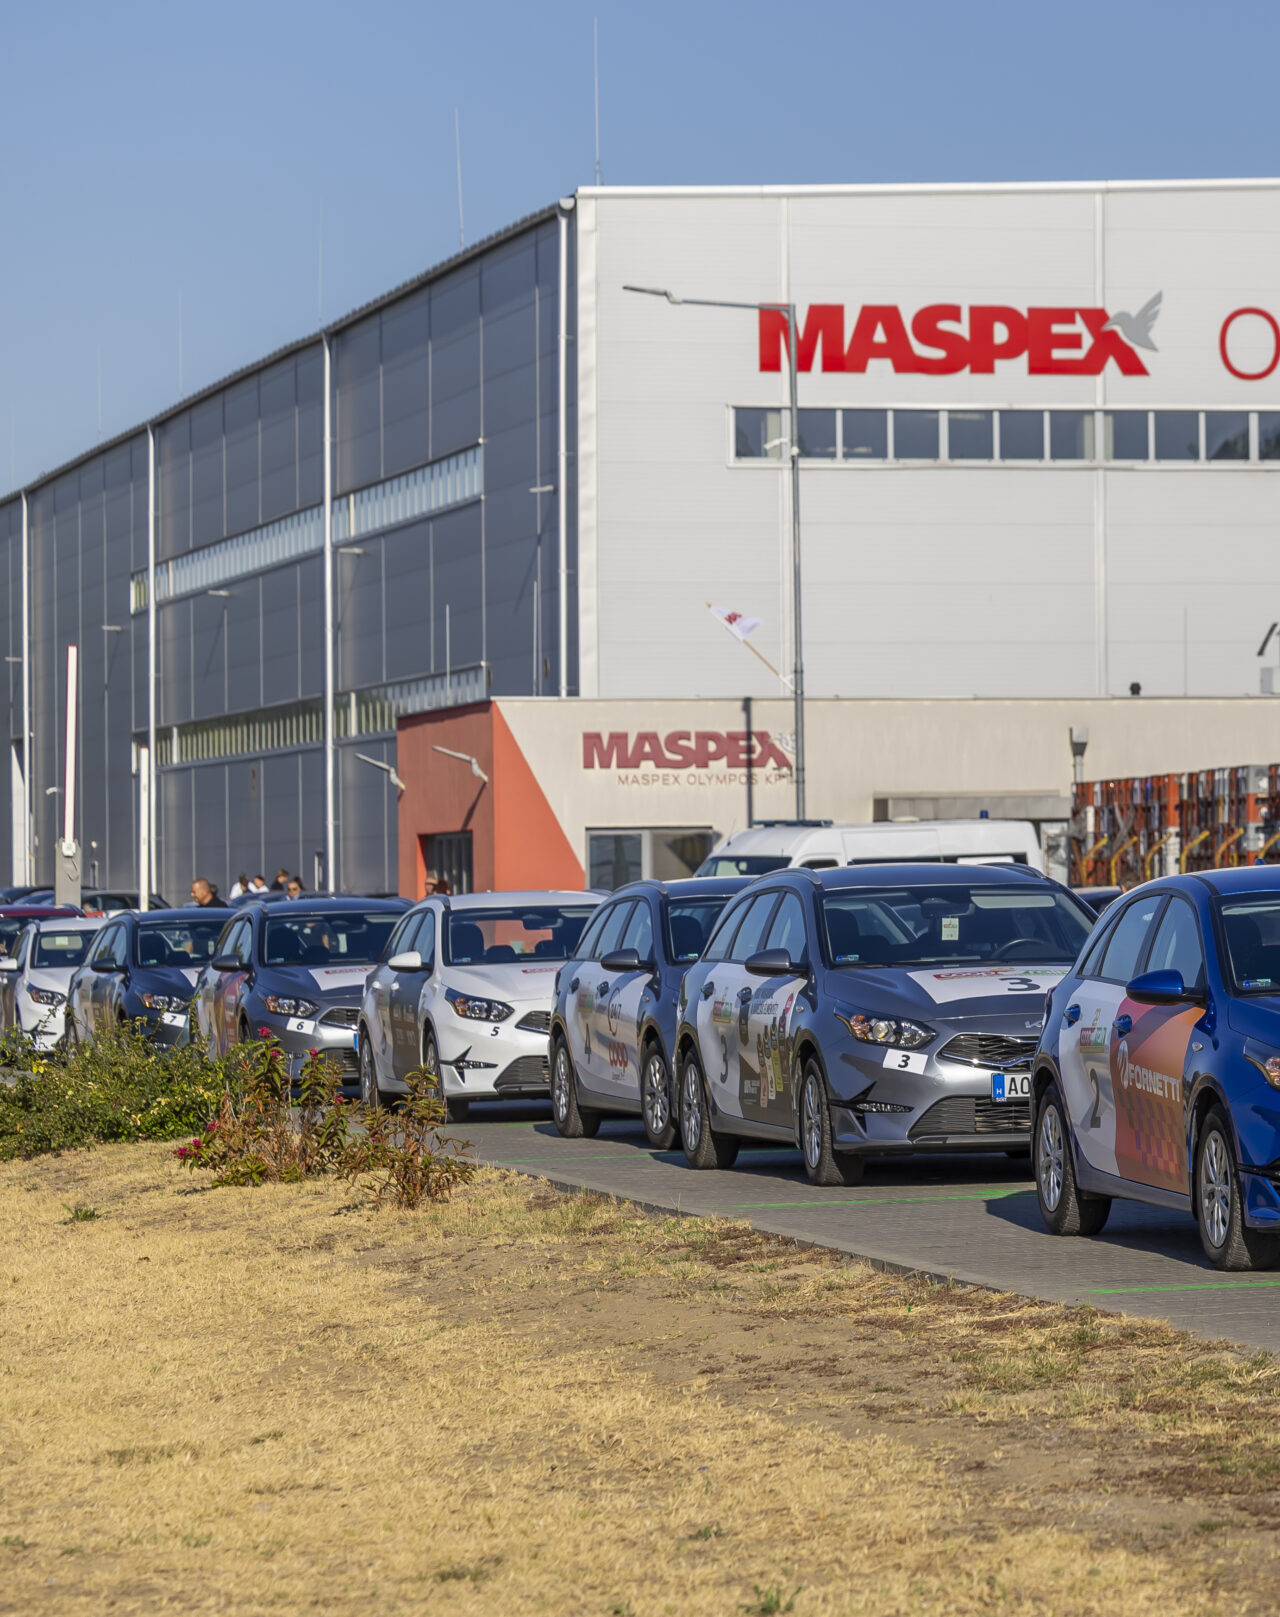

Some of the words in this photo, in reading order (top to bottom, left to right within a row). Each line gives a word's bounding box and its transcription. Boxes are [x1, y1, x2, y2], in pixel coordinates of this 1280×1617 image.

[759, 303, 1150, 376] MASPEX
[582, 731, 792, 769] MASPEX
[617, 773, 681, 786] MASPEX
[686, 773, 759, 786] OLYMPOS
[999, 977, 1041, 991] 3
[296, 1021, 305, 1030] 6
[490, 1026, 500, 1037] 5
[584, 1023, 592, 1064] 4
[720, 1034, 729, 1084] 3
[897, 1054, 911, 1068] 3
[1090, 1068, 1101, 1128] 2
[1128, 1063, 1180, 1102] FORNETTI
